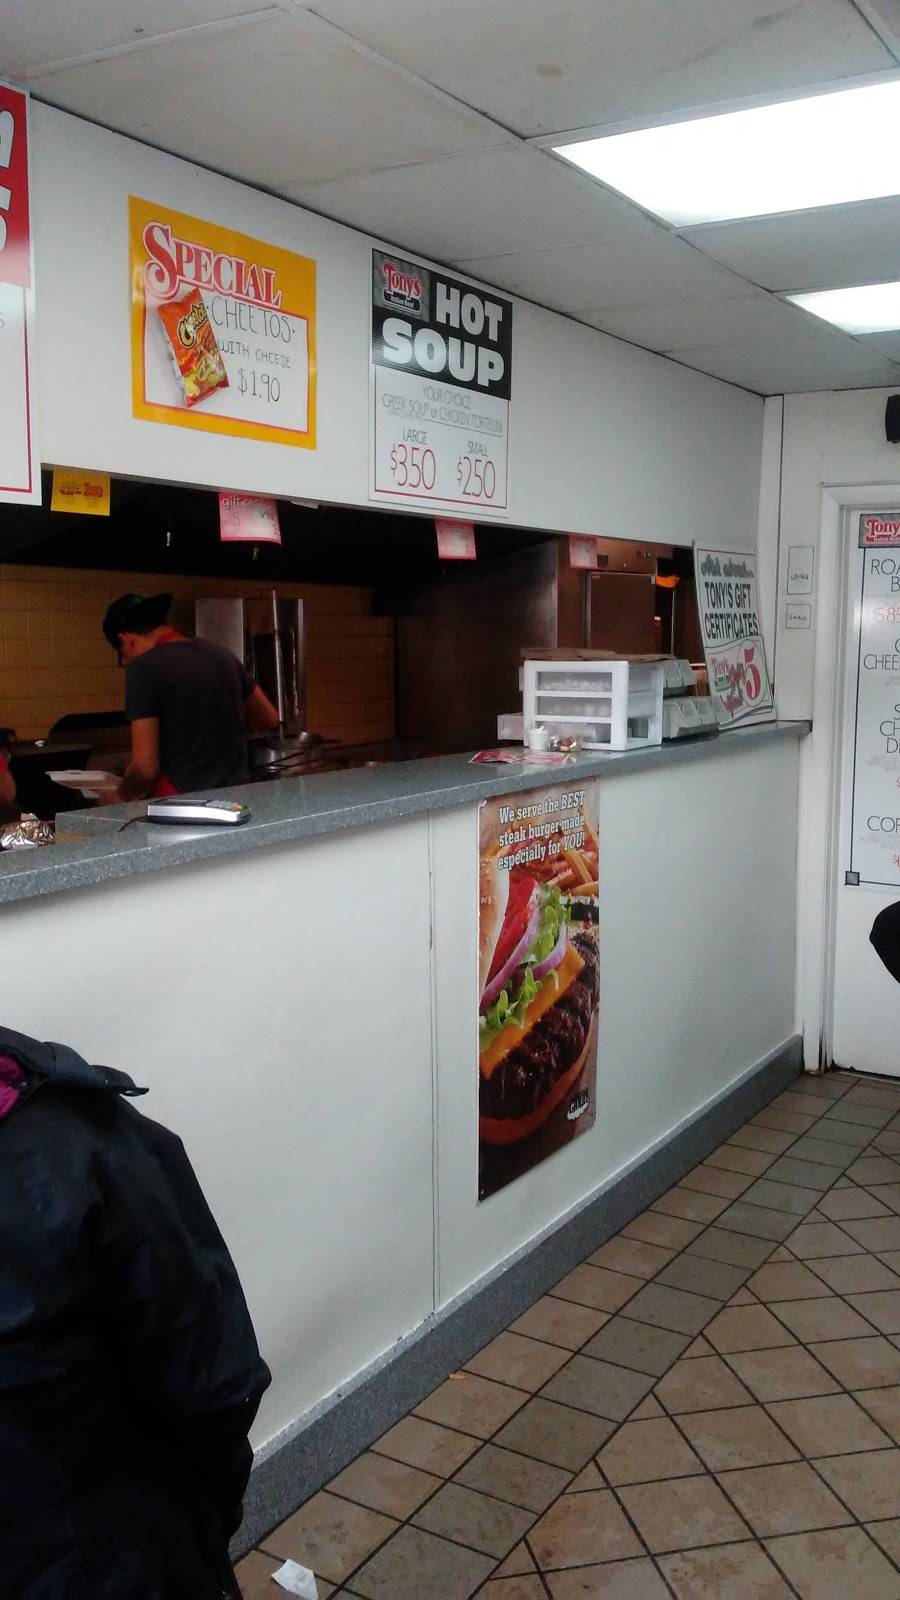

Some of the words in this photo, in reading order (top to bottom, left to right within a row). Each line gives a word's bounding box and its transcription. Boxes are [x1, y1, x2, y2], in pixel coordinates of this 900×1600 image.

[143, 222, 282, 309] SPECIAL
[384, 262, 421, 299] Tony's
[436, 281, 503, 343] HOT
[218, 339, 250, 357] WITH
[255, 348, 291, 368] CHEESE
[382, 317, 504, 387] SOUP
[237, 366, 281, 402] $1.90
[422, 385, 443, 401] YOUR
[444, 390, 471, 409] CHOICE
[409, 400, 430, 416] SOUP
[403, 428, 428, 445] LARGE
[467, 441, 489, 457] SMALL
[705, 582, 733, 609] TONY'S
[735, 583, 751, 609] GIFT
[705, 613, 759, 640] CERTIFICATES
[499, 806, 515, 824] We
[517, 802, 542, 820] serve
[544, 797, 559, 814] the
[561, 790, 587, 809] BEST
[499, 825, 527, 847] steak
[528, 820, 560, 839] burger
[561, 812, 584, 831] made
[498, 844, 547, 871] especially
[548, 839, 561, 855] for
[563, 832, 585, 851] YOU!
